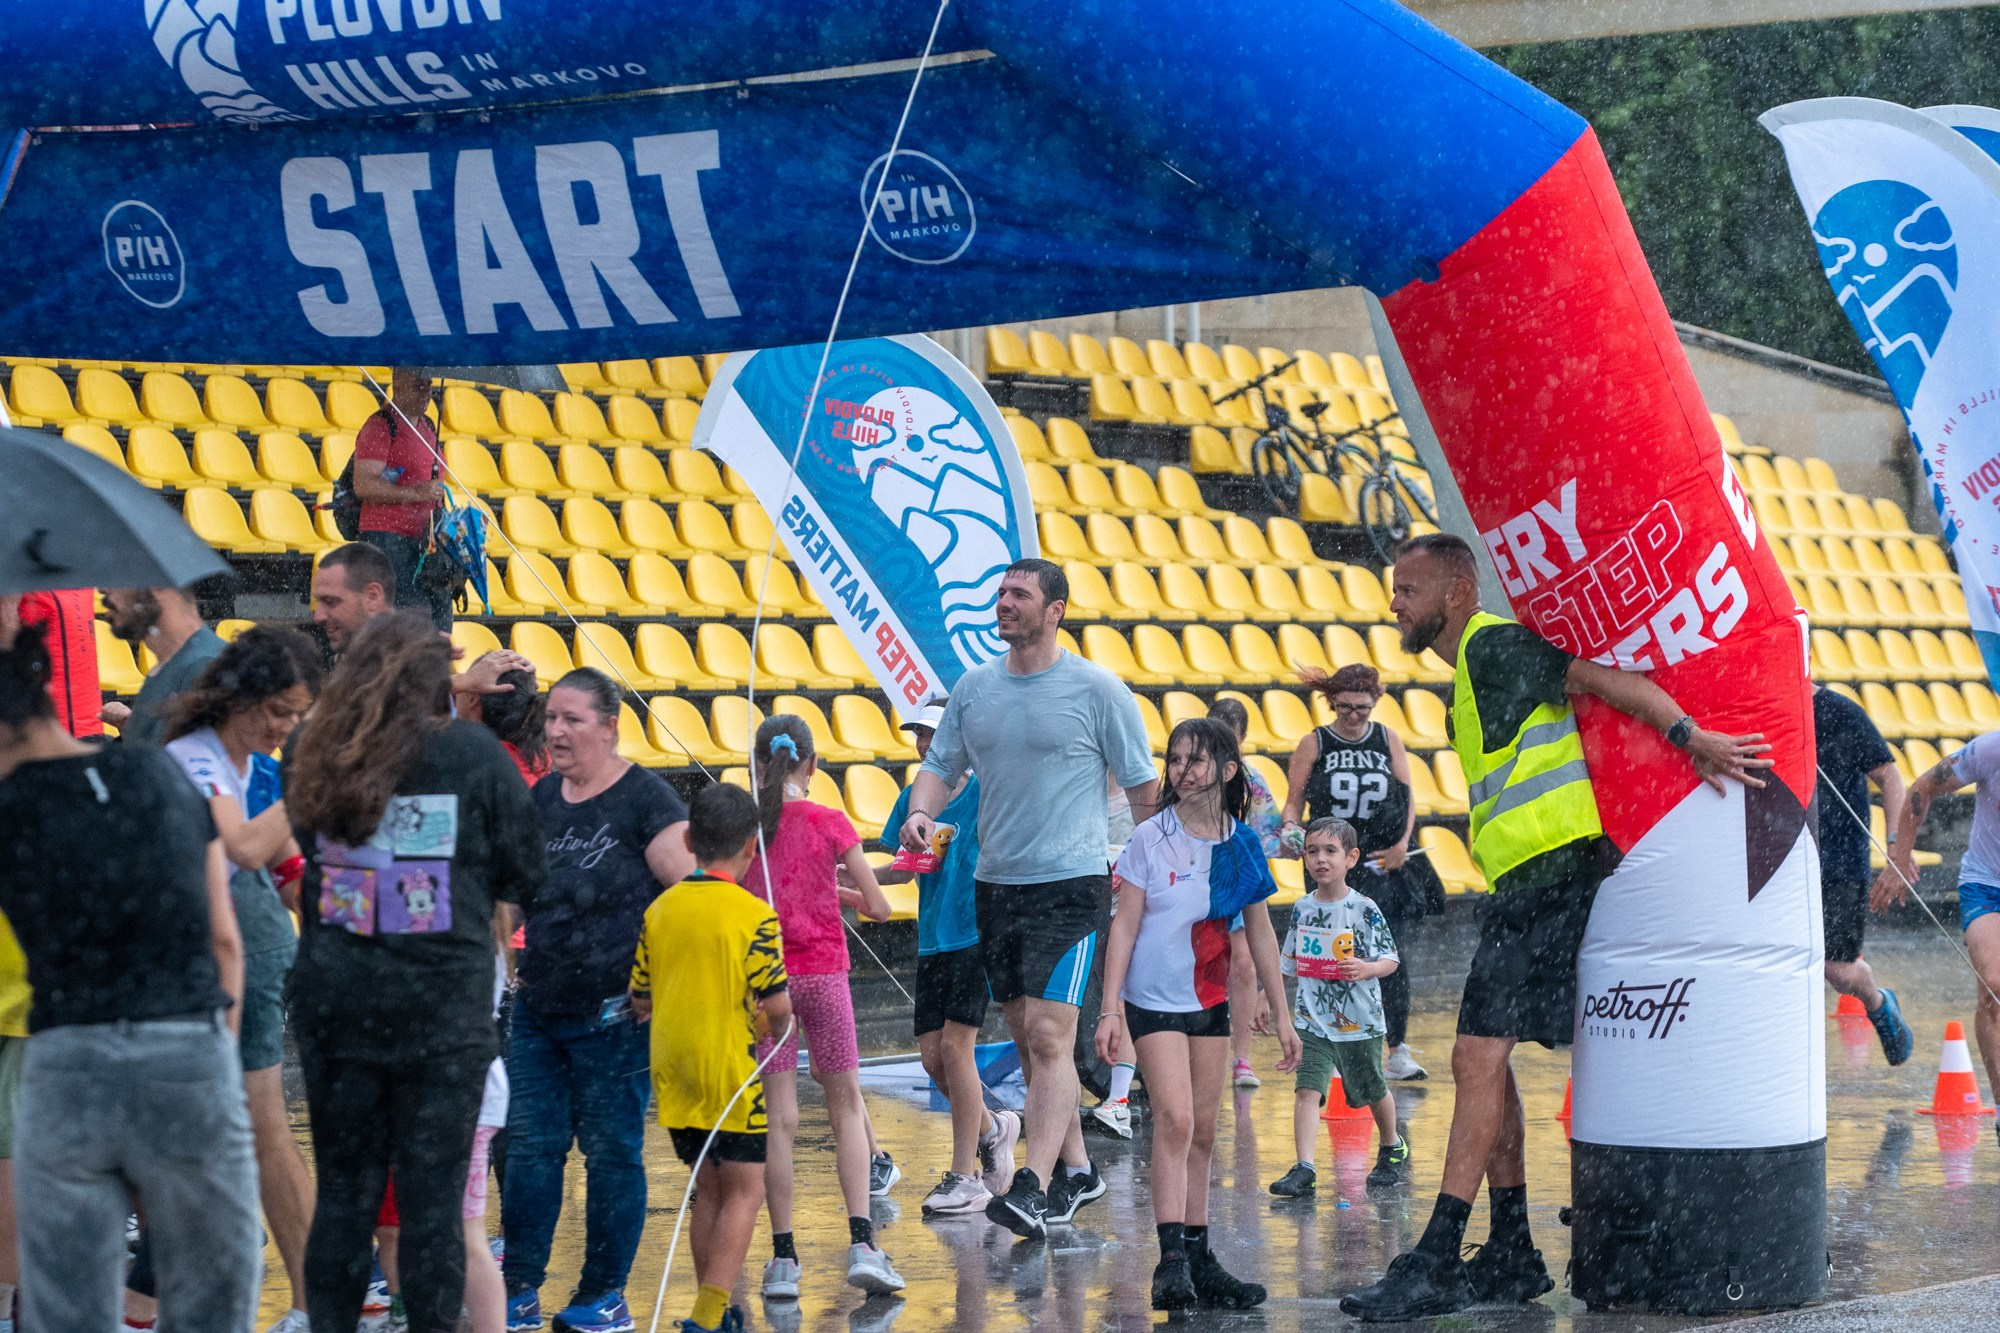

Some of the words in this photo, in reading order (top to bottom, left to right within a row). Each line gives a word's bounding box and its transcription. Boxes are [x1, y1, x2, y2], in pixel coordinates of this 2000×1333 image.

[284, 51, 473, 109] HILLS
[460, 53, 499, 71] IN
[480, 62, 648, 93] MARKOVO
[280, 130, 742, 337] START
[890, 223, 961, 240] MARKOVO
[127, 272, 175, 281] MARKOVO
[1529, 499, 1683, 658] STEP
[1324, 750, 1392, 774] BRNX
[1330, 772, 1388, 820] 92
[1302, 935, 1323, 956] 36
[1590, 1025, 1636, 1039] STUDIO
